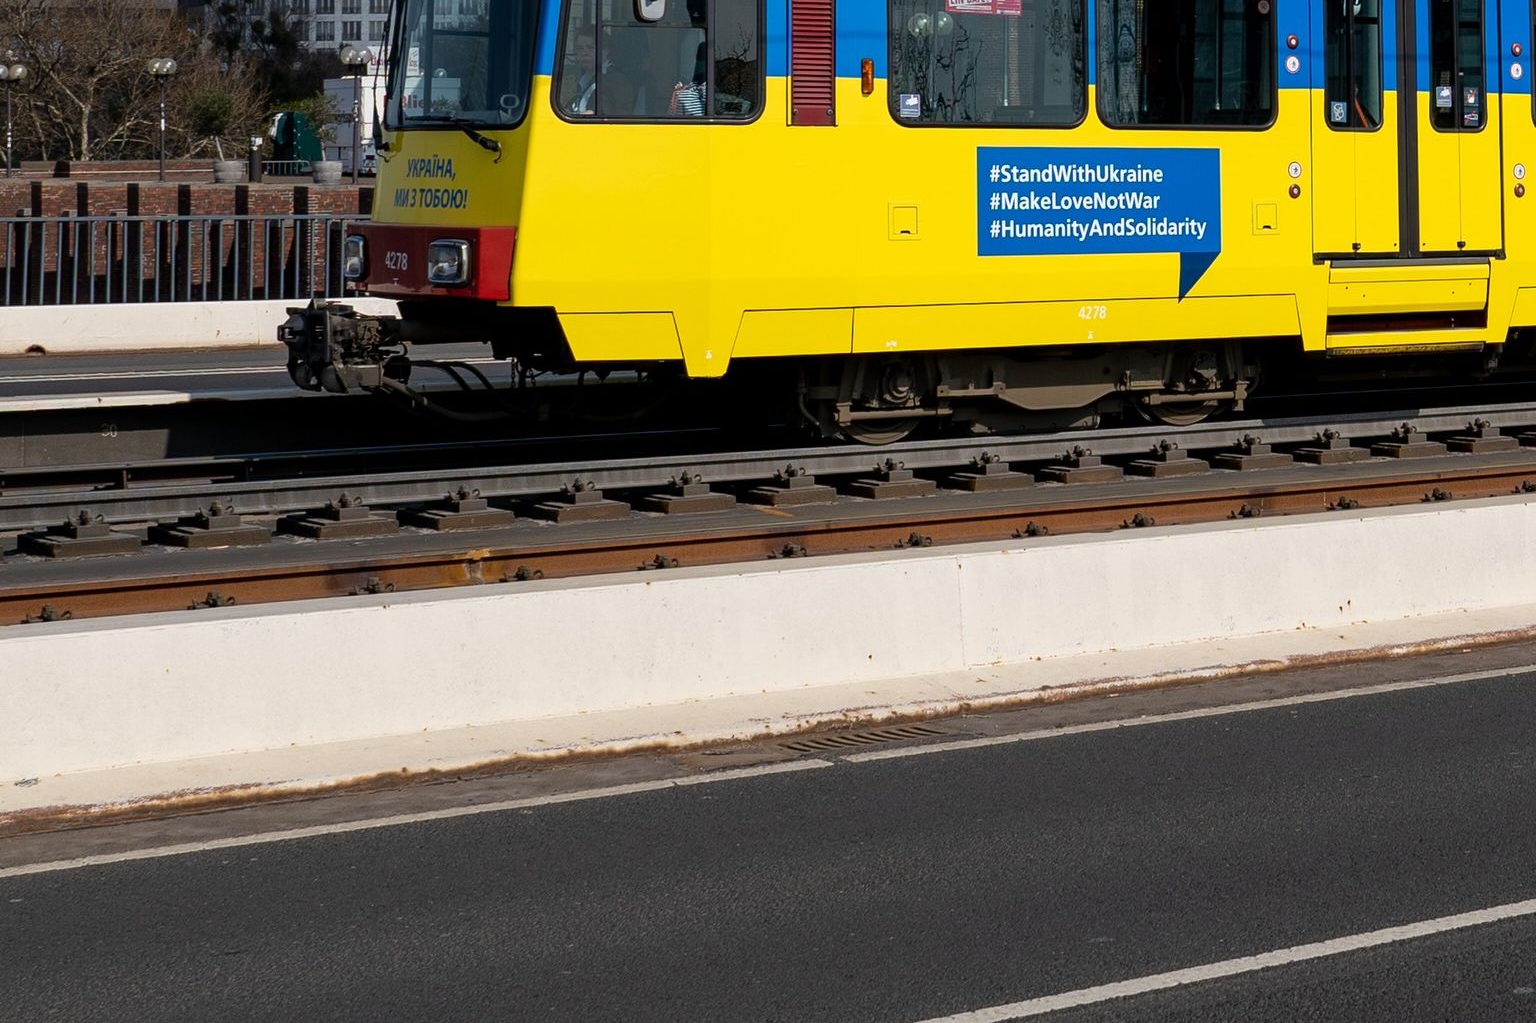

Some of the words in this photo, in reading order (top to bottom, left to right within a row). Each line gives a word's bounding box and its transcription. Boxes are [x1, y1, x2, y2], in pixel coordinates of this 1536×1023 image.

[406, 154, 456, 181] УКРАЇНА,
[989, 164, 1163, 183] #StandWithUkraine
[393, 188, 408, 207] МИ
[419, 189, 468, 209] ТОБОЮ!
[989, 191, 1160, 210] #MakeLoveNotWar
[990, 218, 1206, 241] #HumanityAndSolidarity
[385, 251, 408, 271] 4278
[1078, 305, 1107, 320] 4278
